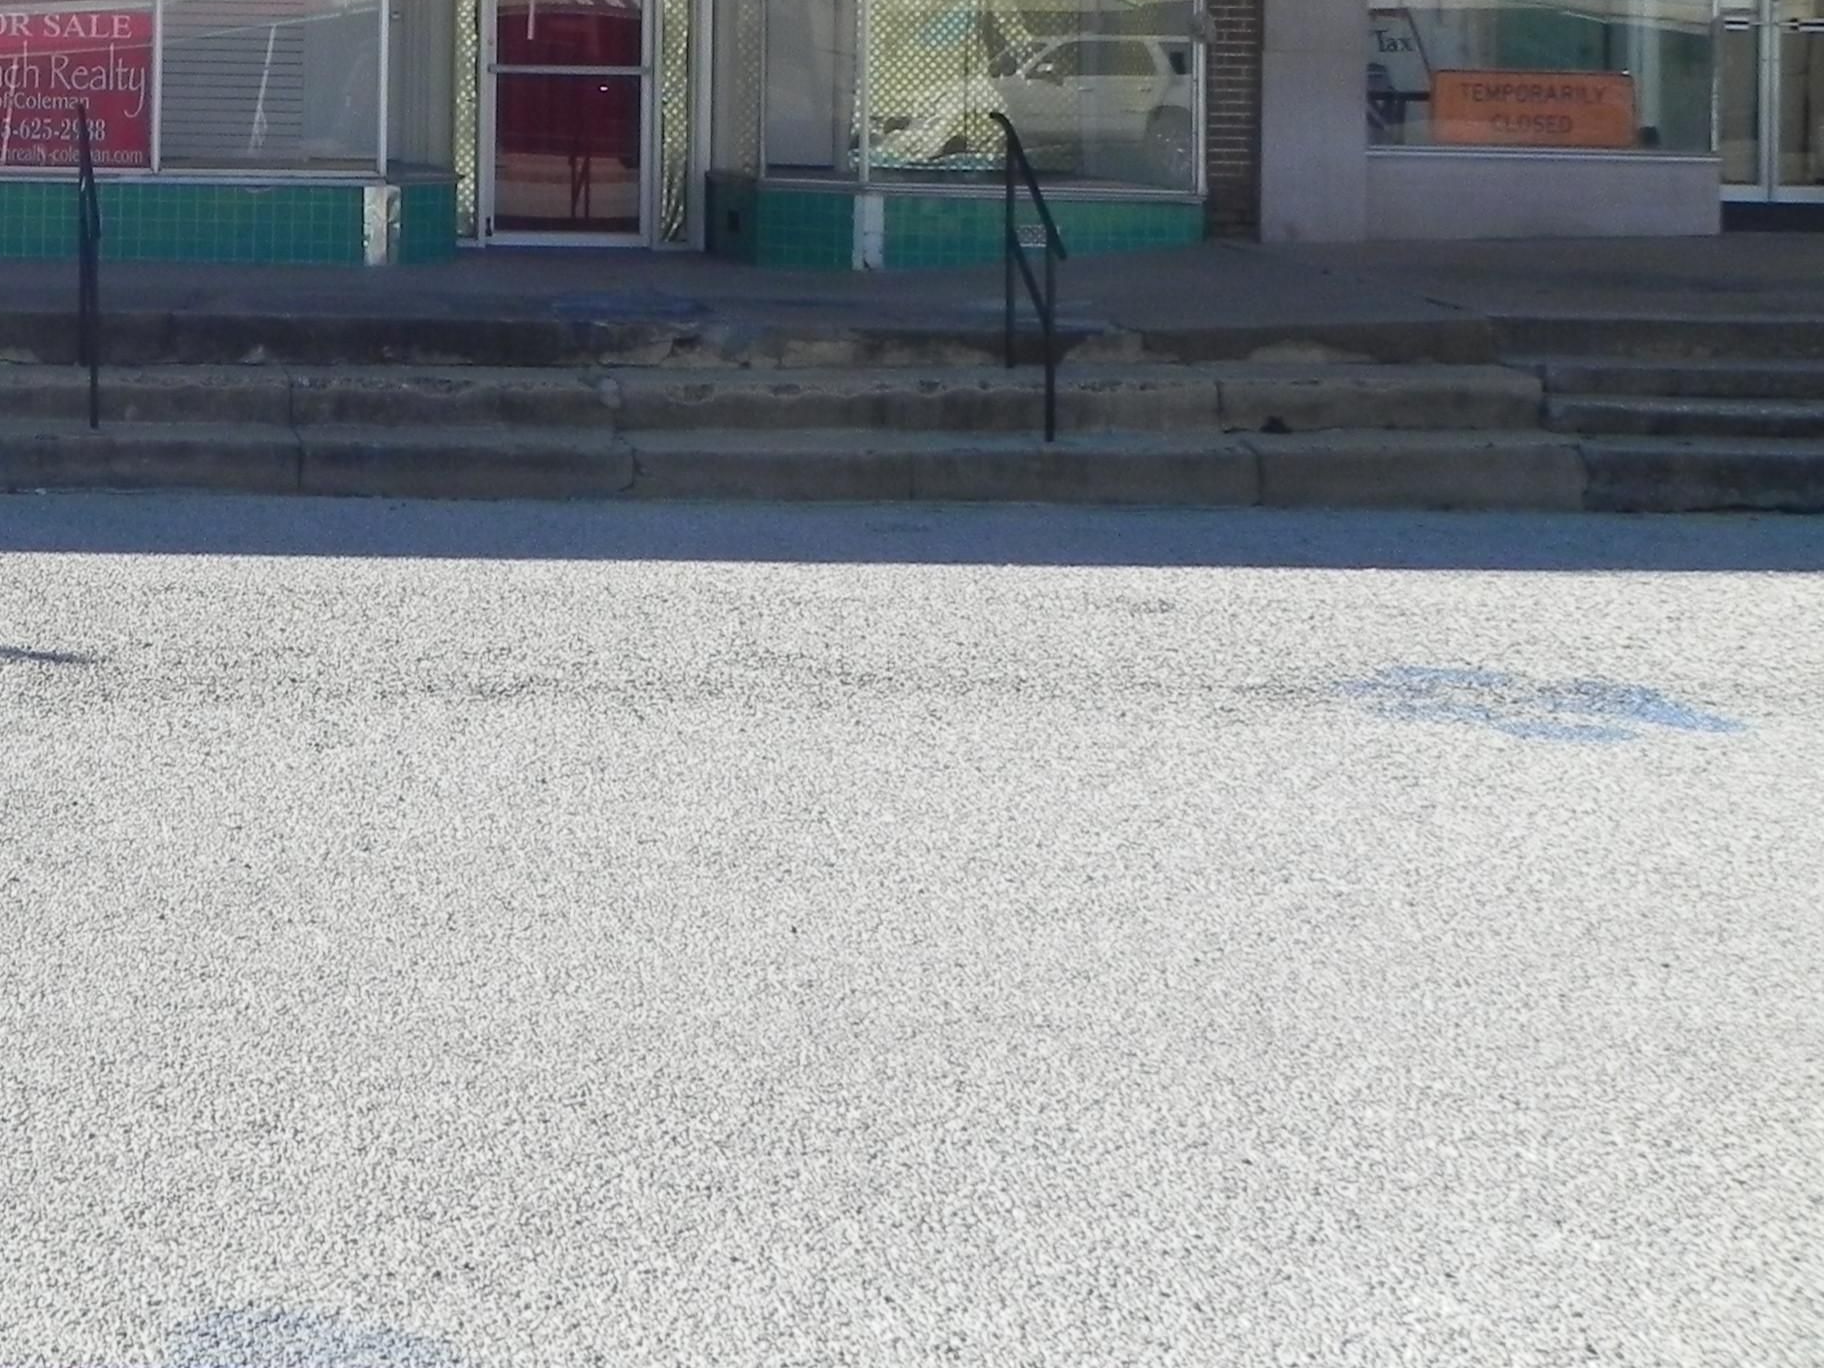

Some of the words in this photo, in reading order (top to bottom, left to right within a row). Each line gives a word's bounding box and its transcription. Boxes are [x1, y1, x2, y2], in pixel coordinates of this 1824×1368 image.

[43, 14, 132, 38] SALE
[1370, 29, 1416, 53] Tax
[50, 43, 146, 118] Realty
[14, 92, 89, 110] Coleman
[1461, 83, 1609, 104] TEMPORARILY
[1490, 113, 1573, 133] CLOSED
